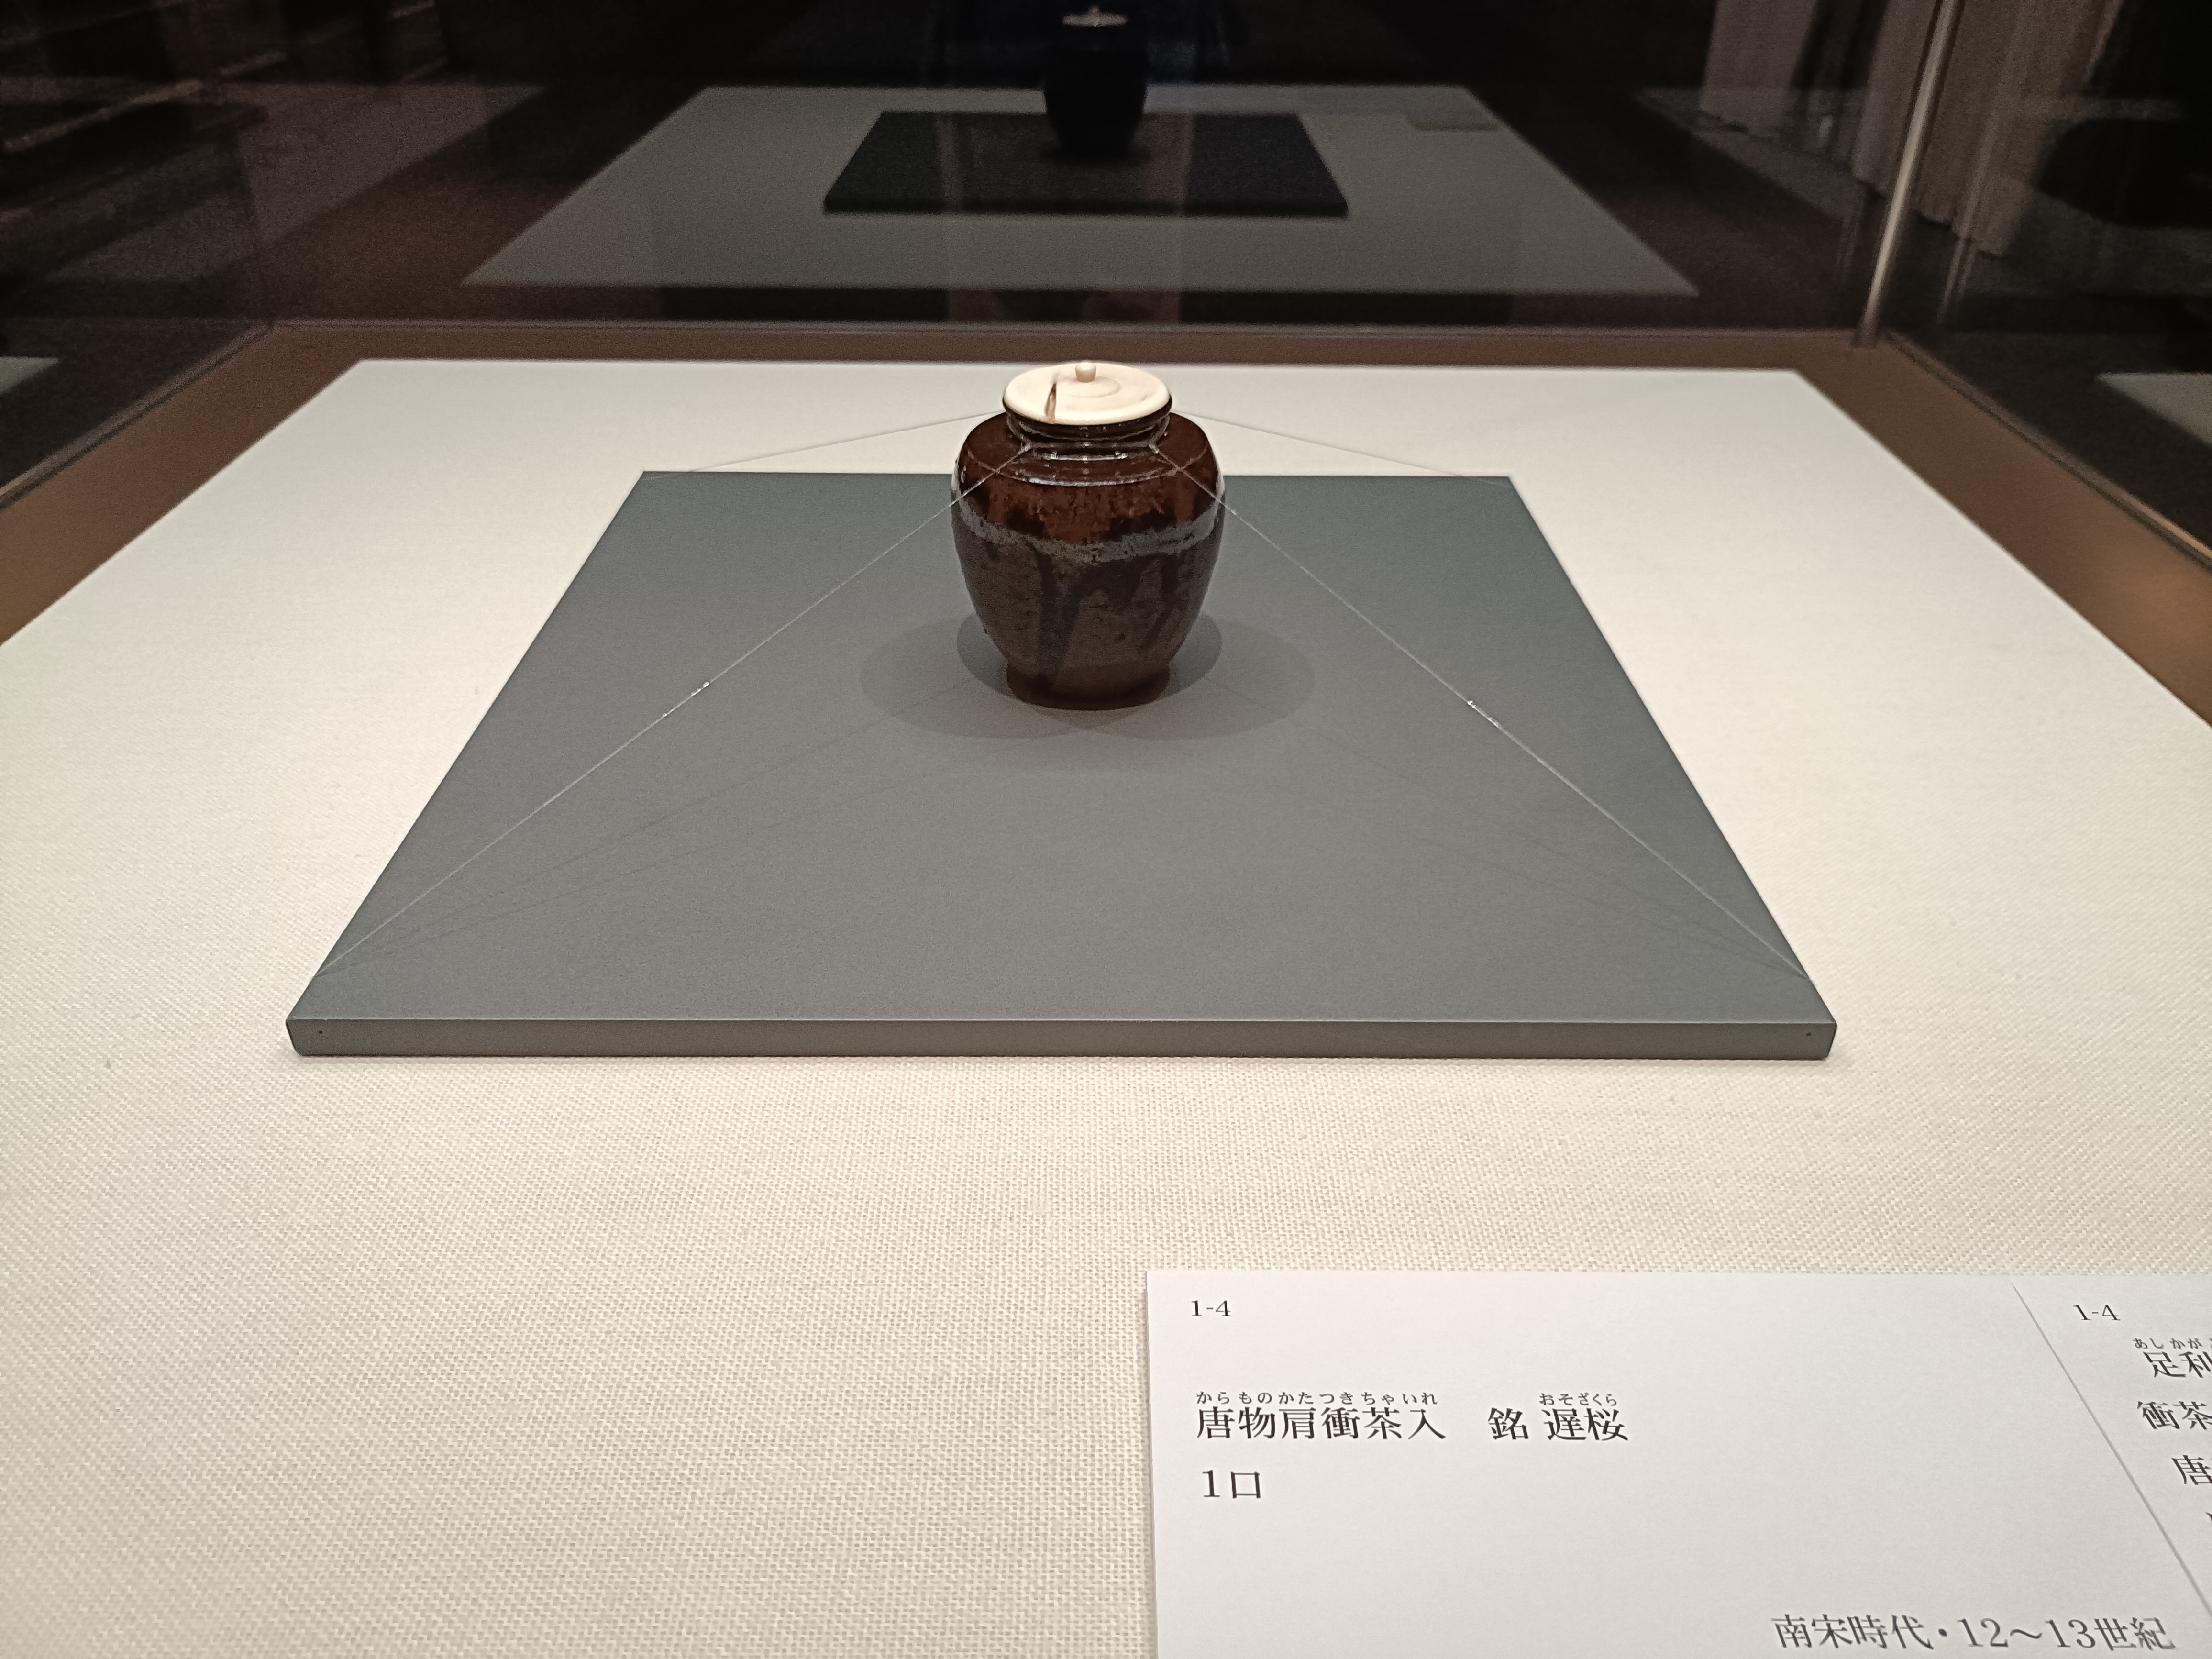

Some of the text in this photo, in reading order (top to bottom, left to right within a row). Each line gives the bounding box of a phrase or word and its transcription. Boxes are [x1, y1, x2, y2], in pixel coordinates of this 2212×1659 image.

[1191, 1300, 1231, 1317] 1-4
[2073, 1305, 2121, 1321] 1-4
[2132, 1338, 2212, 1349] あしかが
[1539, 1392, 1617, 1406] おそざくら
[1196, 1406, 1628, 1441] 唐物肩衝茶入 銘 遅桜
[1202, 1469, 1261, 1499] 1口
